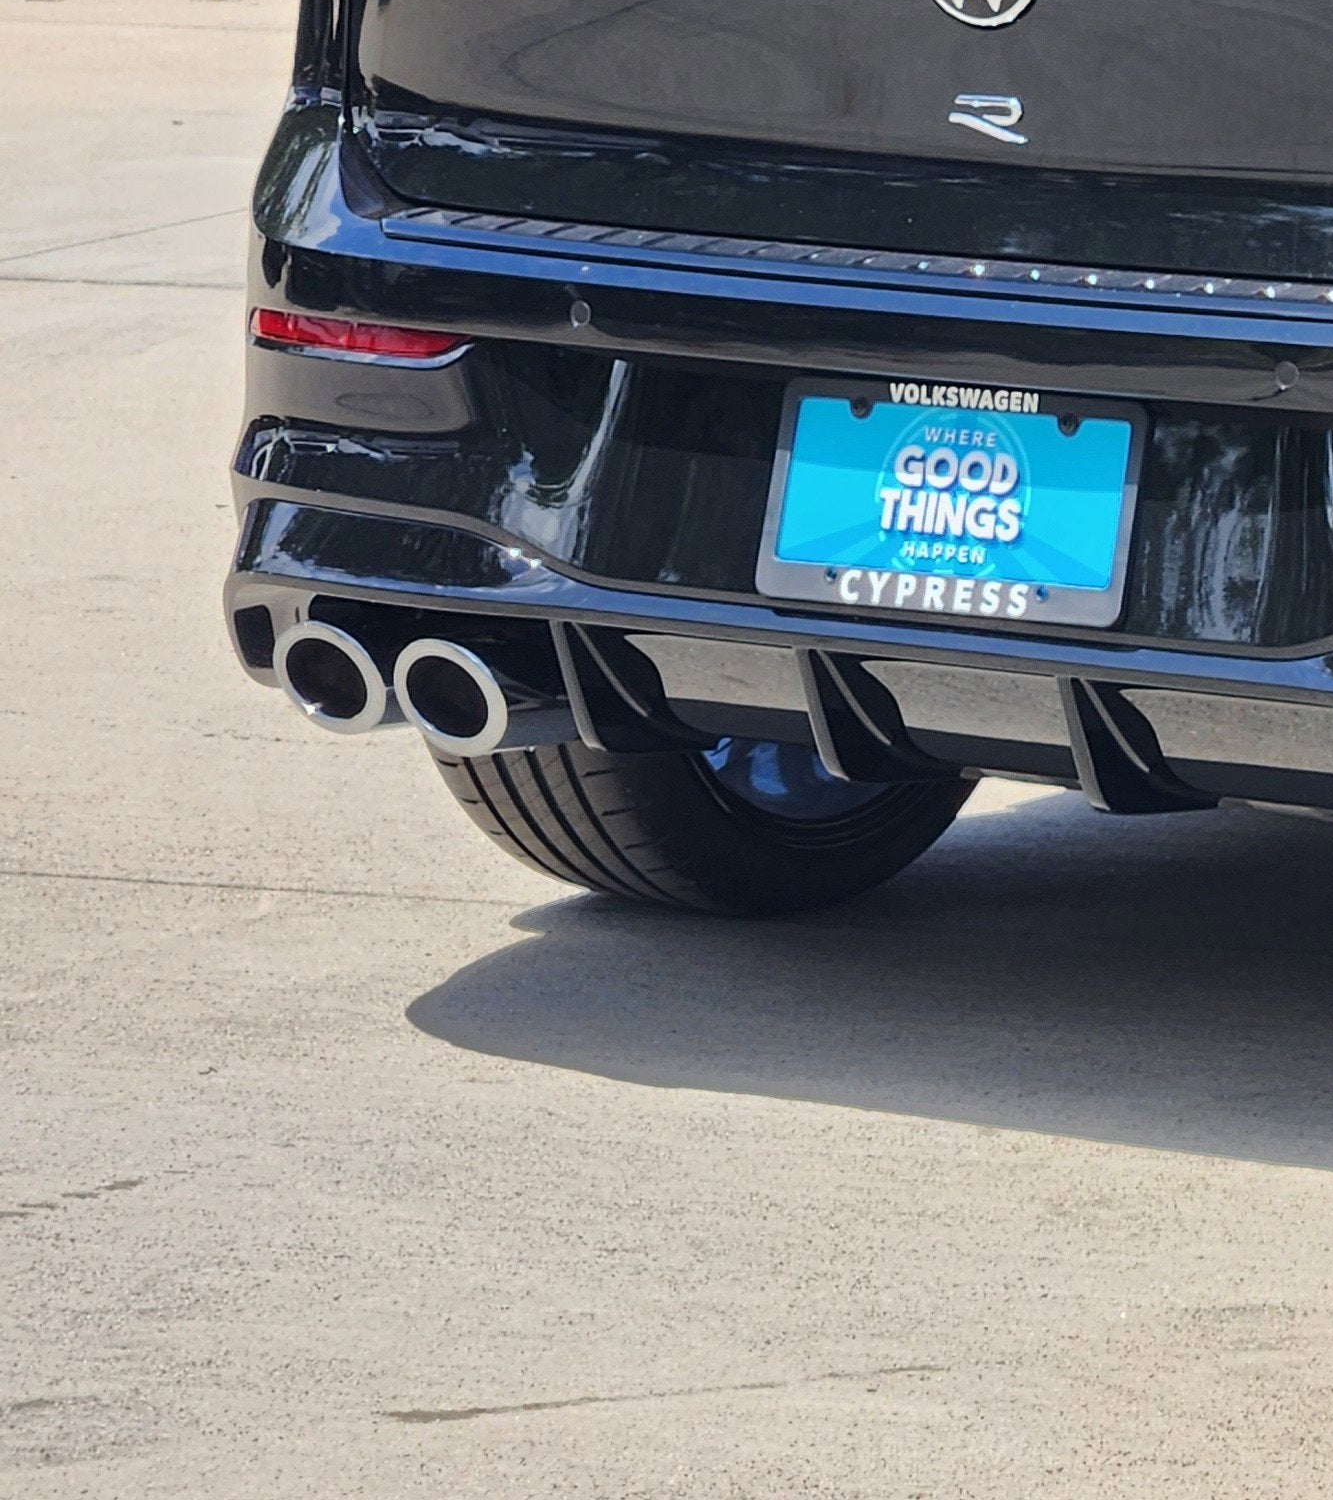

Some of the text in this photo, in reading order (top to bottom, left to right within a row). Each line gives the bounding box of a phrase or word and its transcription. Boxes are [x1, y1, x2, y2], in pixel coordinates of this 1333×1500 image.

[948, 94, 1029, 145] R
[889, 382, 1039, 413] VOLKSWAGEN
[924, 426, 998, 447] WHERE
[894, 445, 1020, 494] GOOD
[880, 488, 1022, 542] THINGS
[901, 541, 986, 564] HAPPEN
[839, 569, 1030, 617] CYPRESS
